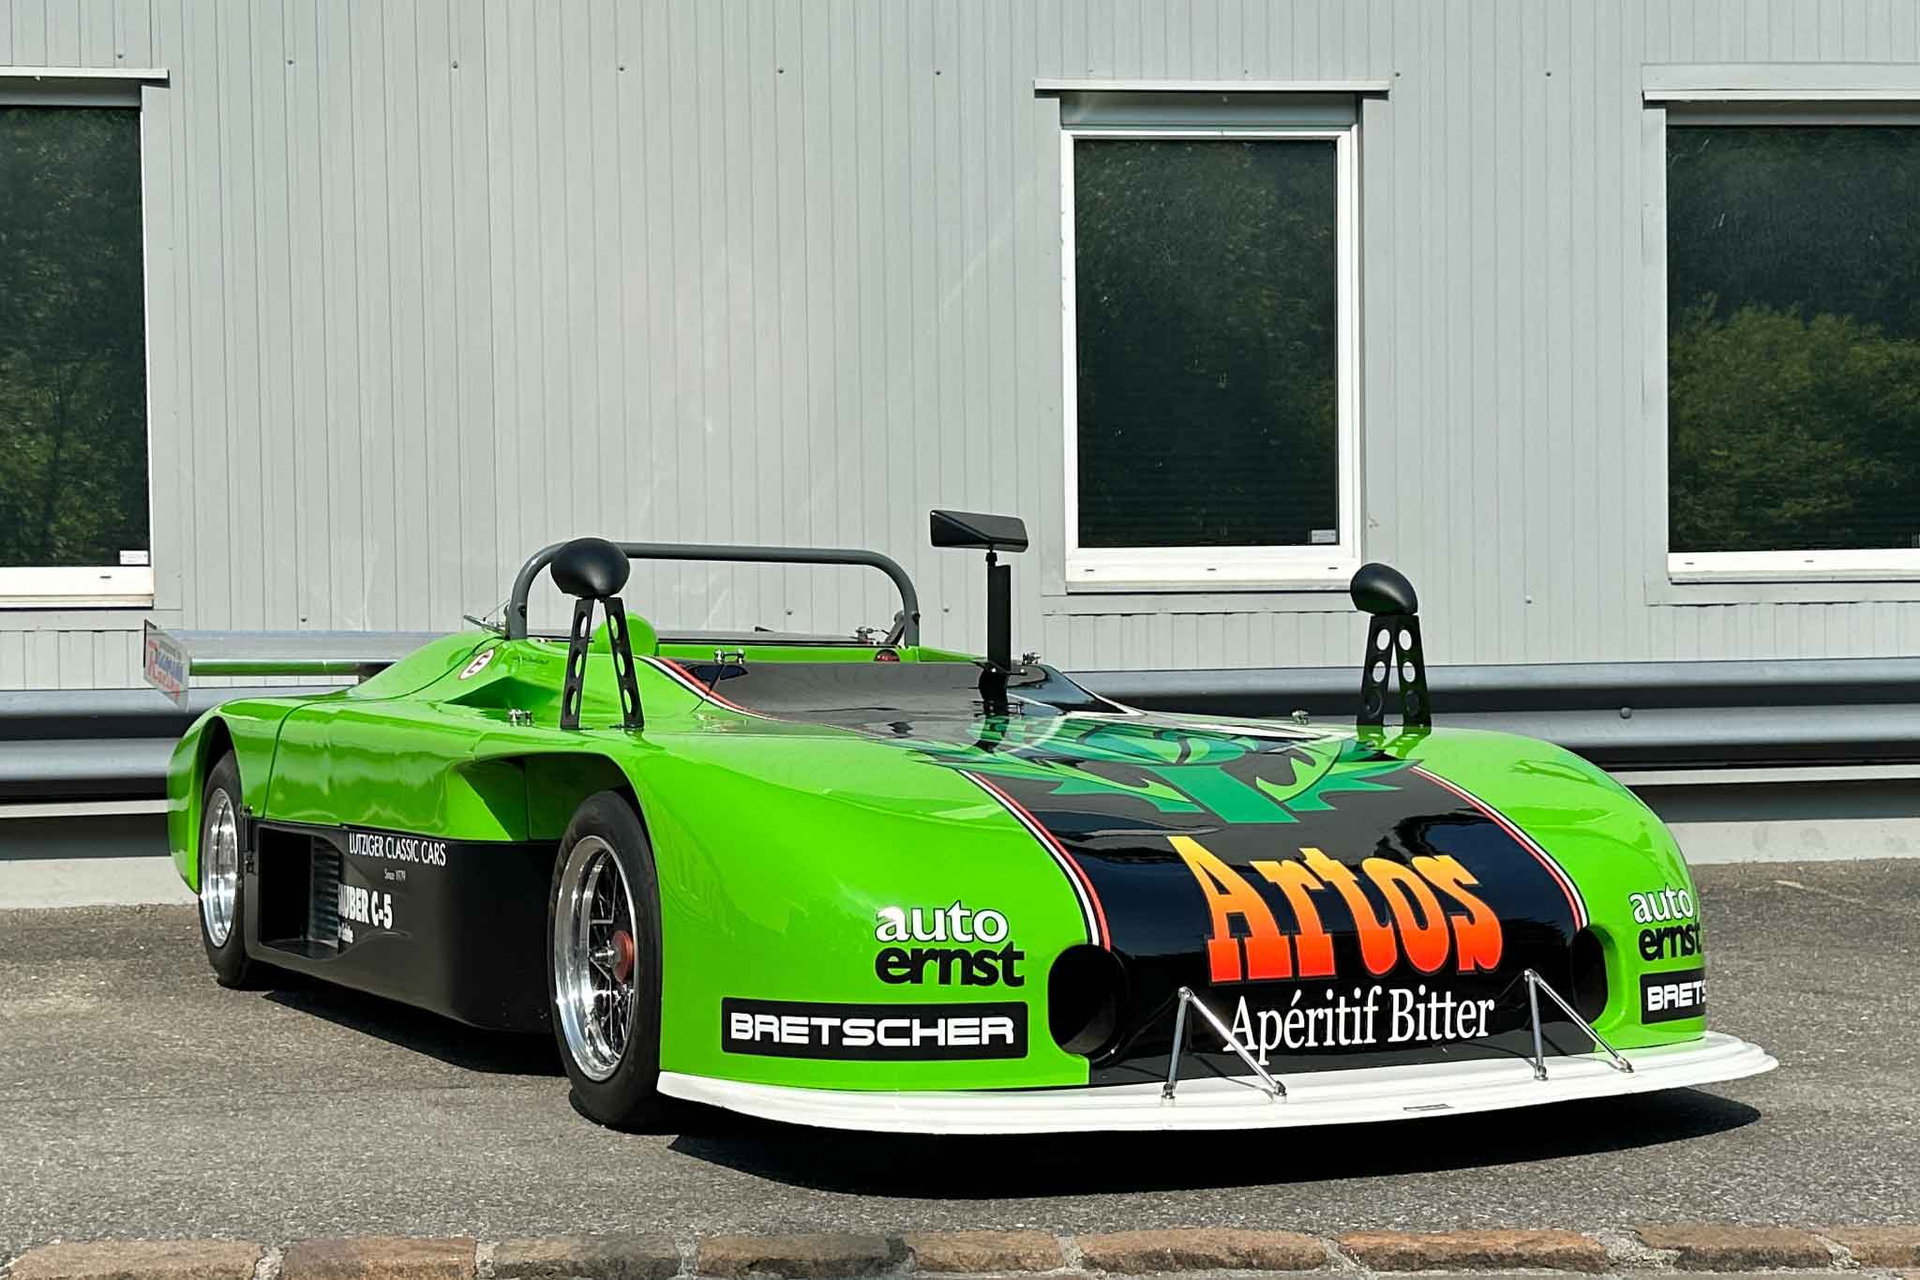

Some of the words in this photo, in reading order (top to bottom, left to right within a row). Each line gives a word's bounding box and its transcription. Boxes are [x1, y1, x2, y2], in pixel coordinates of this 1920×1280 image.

[348, 832, 384, 858] LUTZIGER
[385, 836, 419, 862] CLASSIC
[421, 840, 447, 867] CARS
[370, 890, 393, 930] C-5
[874, 900, 1010, 943] auto
[1166, 835, 1504, 984] Artos
[1628, 882, 1694, 924] auto
[1638, 915, 1702, 961] ernst
[874, 941, 1025, 988] ernst
[730, 1011, 1015, 1047] BRETSCHER
[1223, 985, 1382, 1066] Apéritif
[1387, 984, 1496, 1044] Bitter
